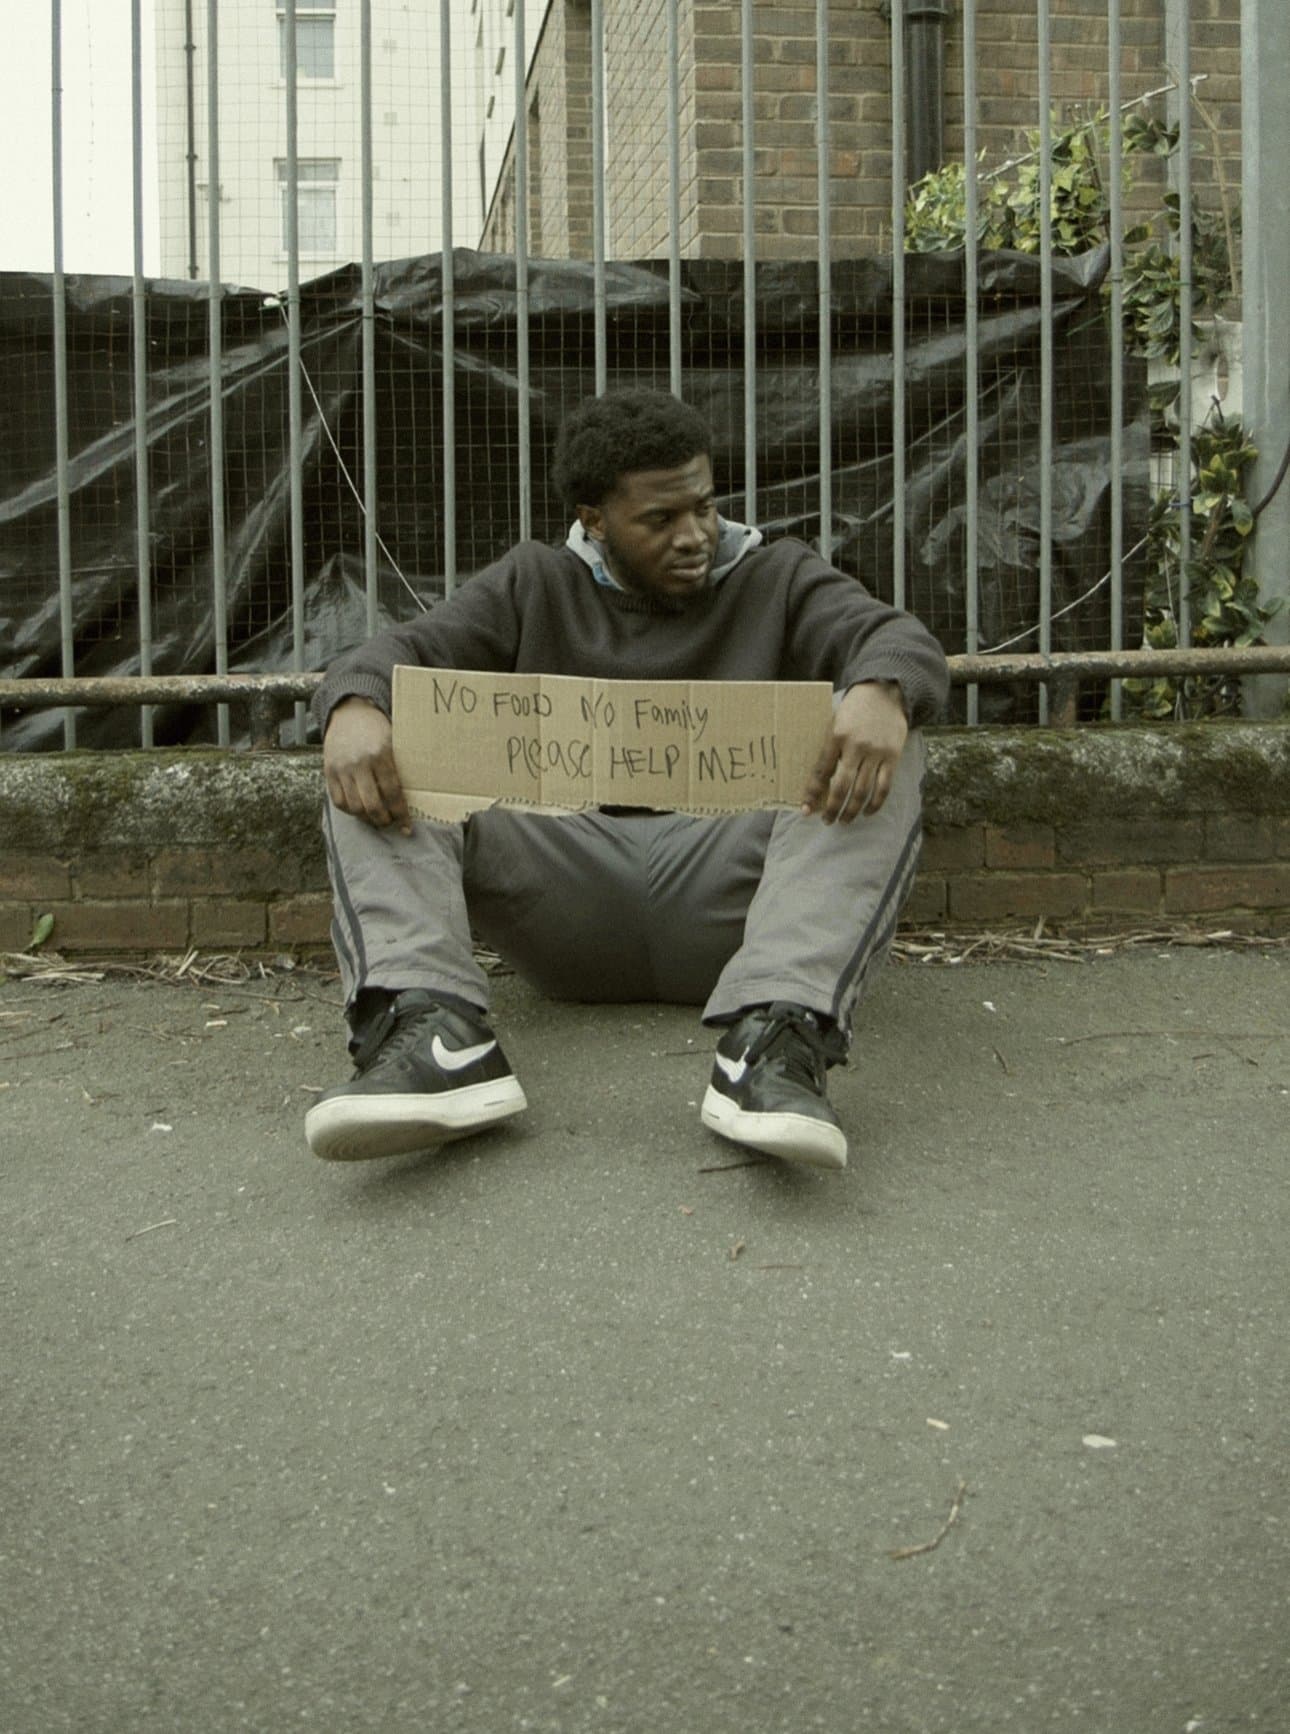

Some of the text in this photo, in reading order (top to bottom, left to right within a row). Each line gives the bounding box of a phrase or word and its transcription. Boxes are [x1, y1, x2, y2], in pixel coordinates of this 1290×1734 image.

[432, 678, 709, 741] NO FOOD NO Family
[610, 745, 681, 779] HELP
[698, 736, 778, 784] ME!!!
